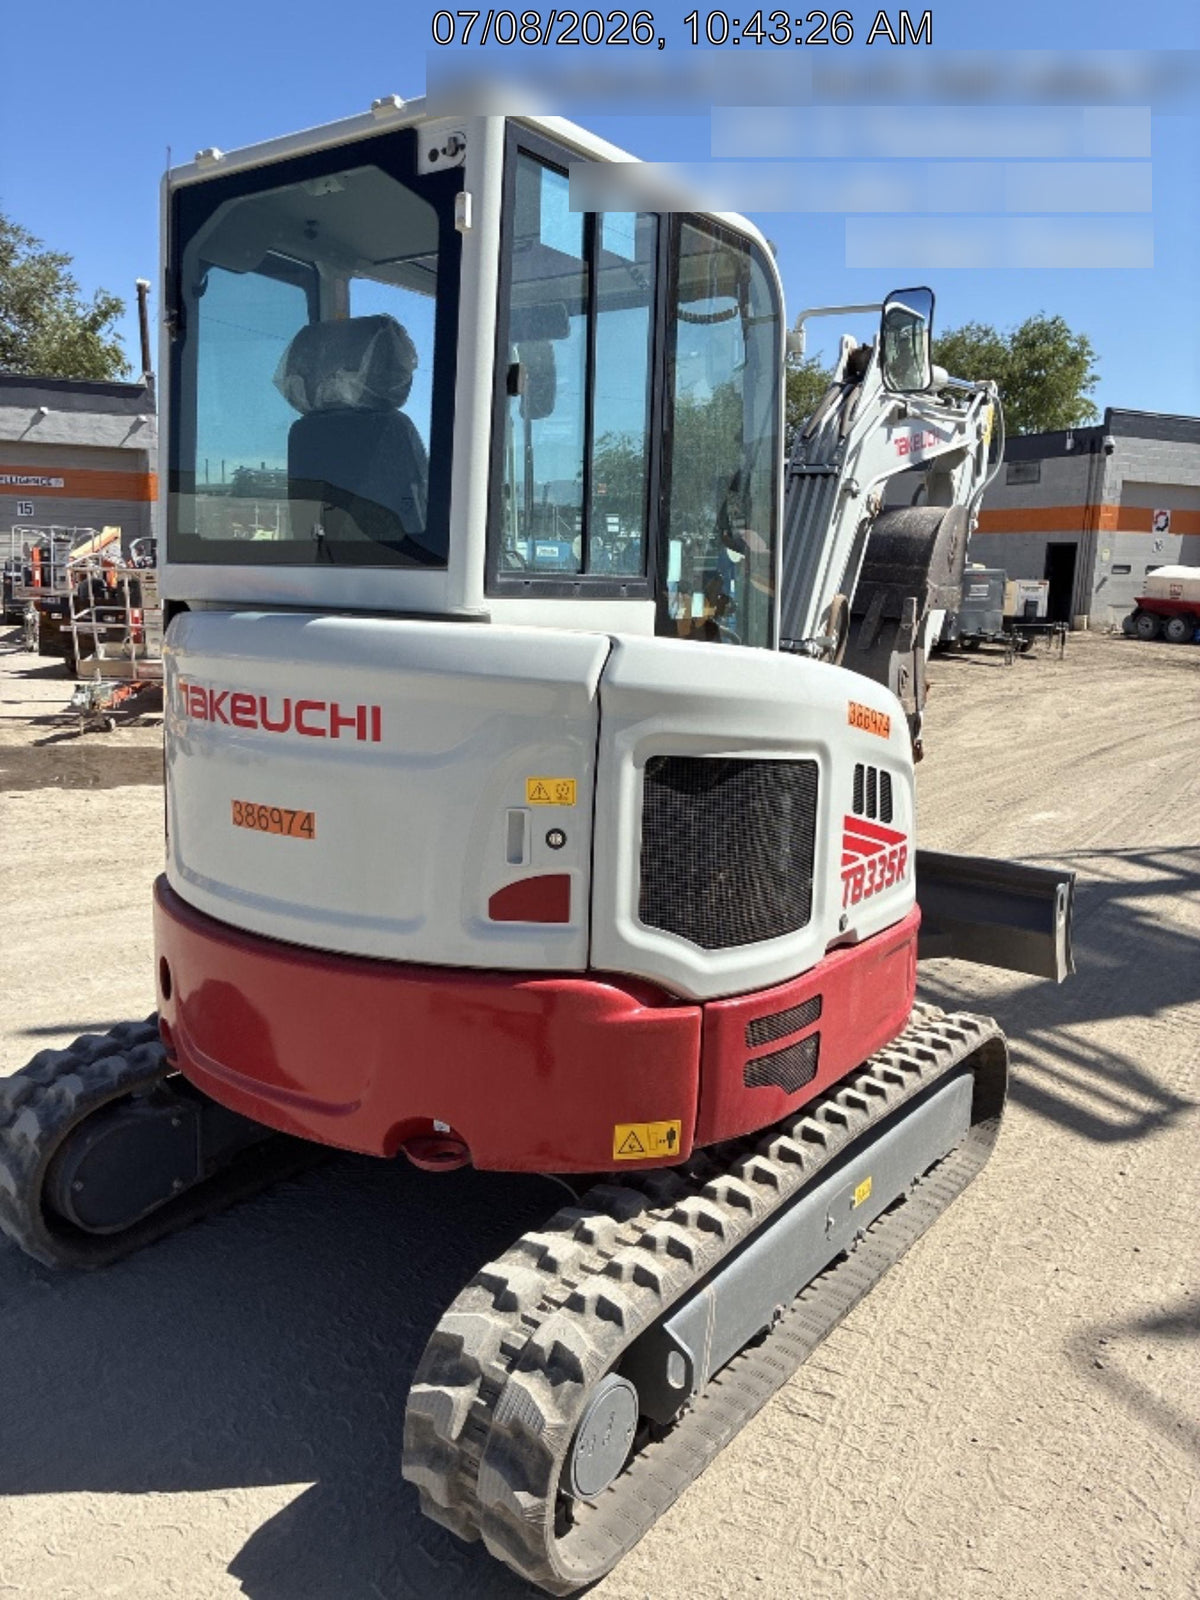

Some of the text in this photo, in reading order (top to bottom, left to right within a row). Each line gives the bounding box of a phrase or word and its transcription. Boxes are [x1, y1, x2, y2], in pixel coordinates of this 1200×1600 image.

[19, 502, 33, 515] 15
[232, 800, 315, 838] 386974
[841, 844, 908, 908] TB335R
